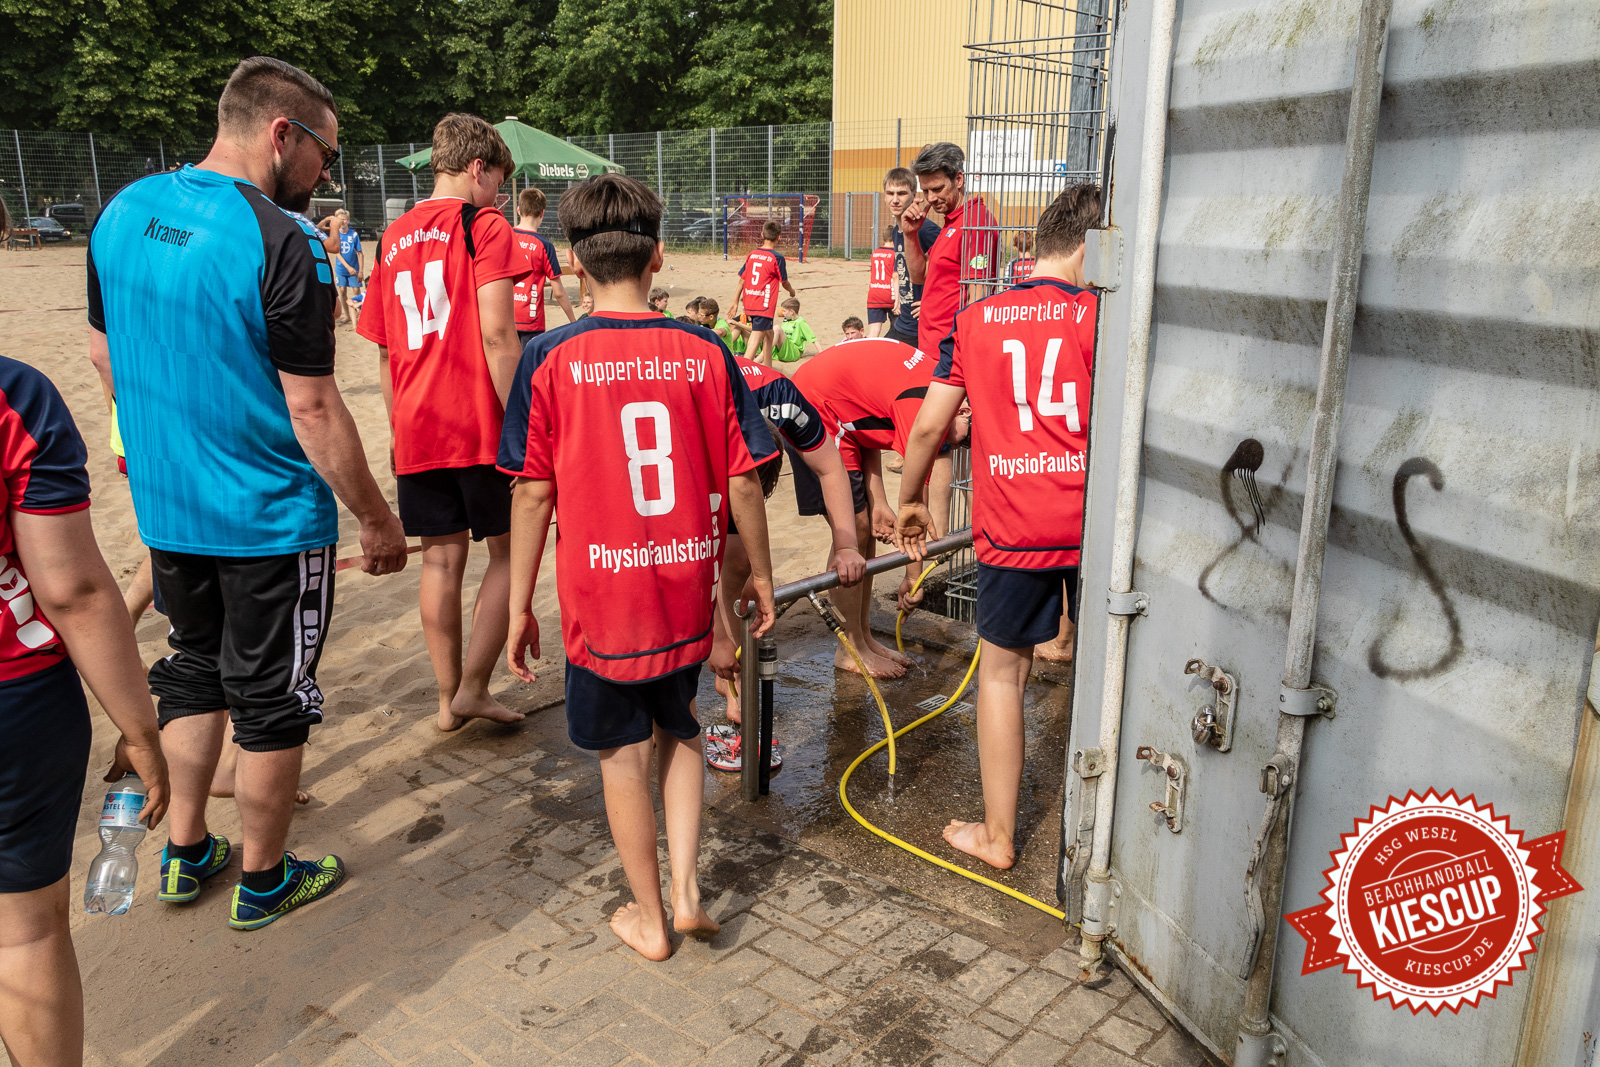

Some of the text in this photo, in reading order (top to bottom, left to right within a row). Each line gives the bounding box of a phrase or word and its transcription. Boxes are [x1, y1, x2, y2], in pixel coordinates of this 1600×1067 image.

[538, 162, 575, 177] Diebels
[143, 216, 194, 247] Kramer
[384, 243, 398, 267] TuS
[399, 233, 413, 250] 08
[751, 262, 763, 286] 5
[874, 260, 886, 281] 11
[394, 259, 451, 350] 14
[983, 300, 1068, 325] Wuppertaler
[569, 356, 706, 387] Wuppertaler SV
[1002, 338, 1082, 433] 14
[620, 401, 676, 517] 8
[989, 450, 1087, 480] PhysioFaulst
[588, 534, 712, 574] PhysioFaulstich
